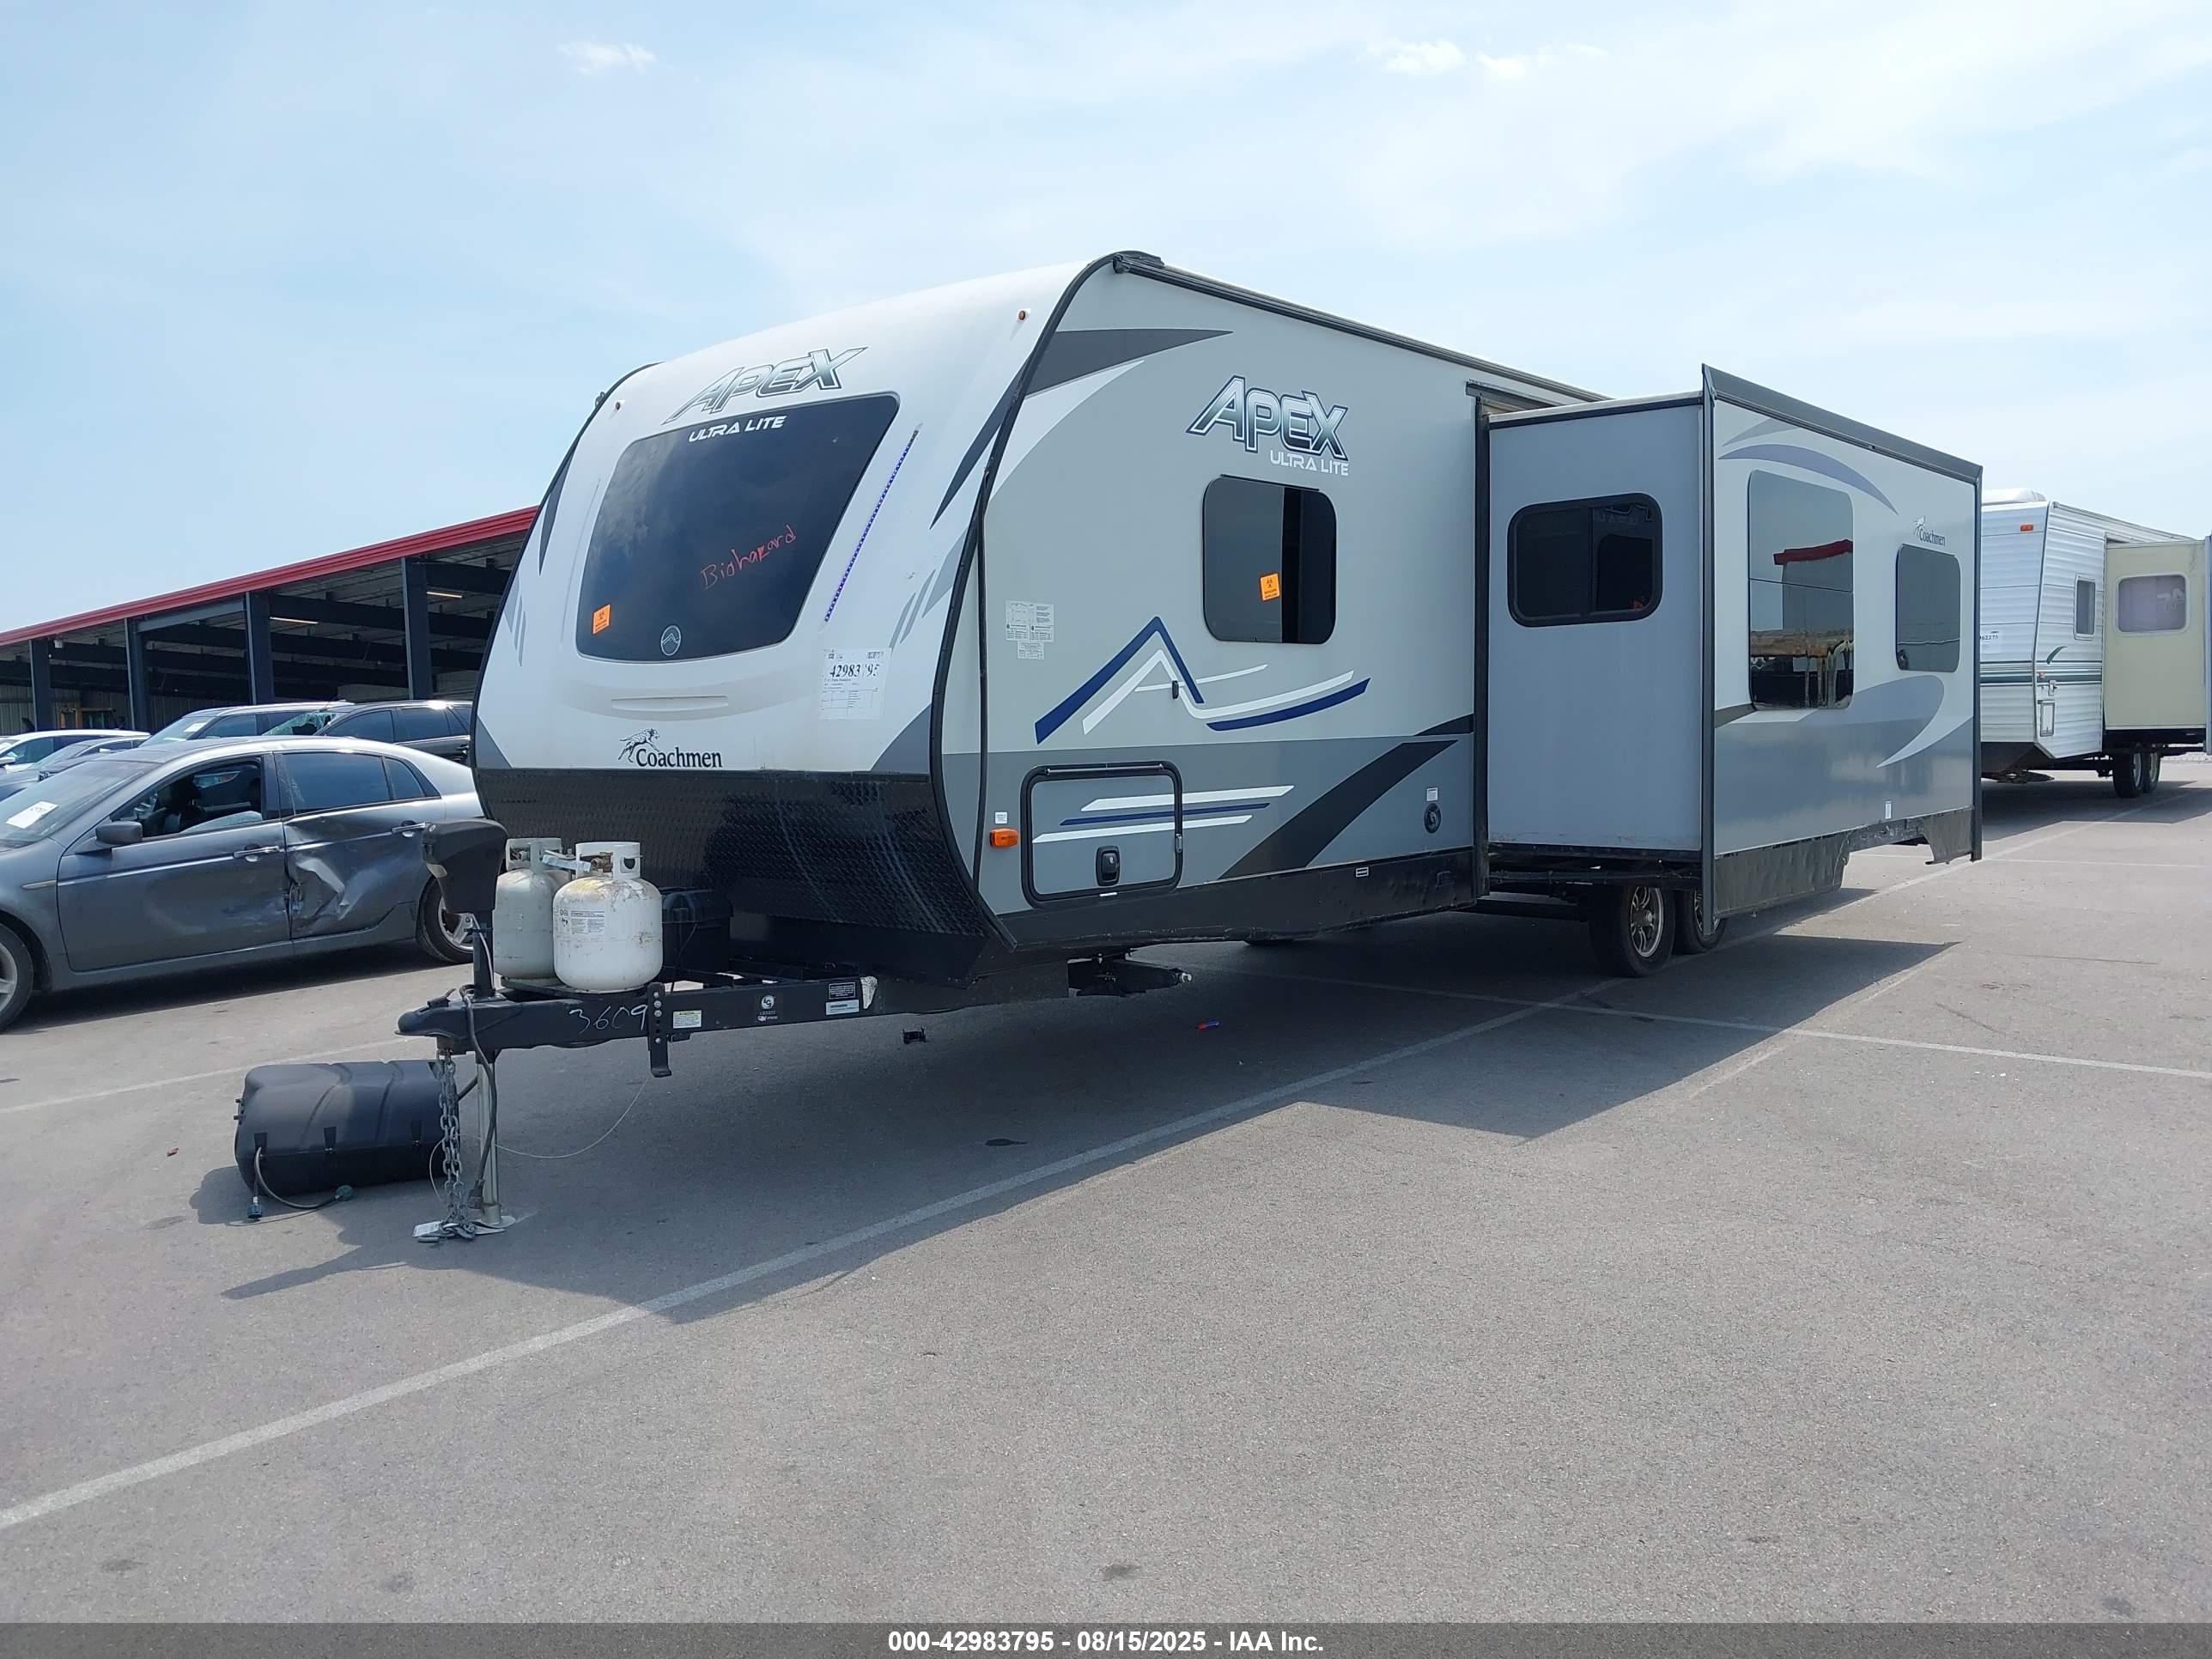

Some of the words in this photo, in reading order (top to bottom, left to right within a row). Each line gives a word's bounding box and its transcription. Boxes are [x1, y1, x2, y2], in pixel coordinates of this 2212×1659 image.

[661, 347, 868, 425] APEX
[689, 422, 739, 442] ULTRA
[744, 416, 787, 433] LITE
[1185, 375, 1349, 461] APEX
[1270, 450, 1317, 471] ULTRA
[1321, 459, 1350, 476] LITE
[1918, 528, 1946, 547] Coachmen
[701, 524, 796, 589] Biohazard
[636, 746, 723, 768] Coachmen
